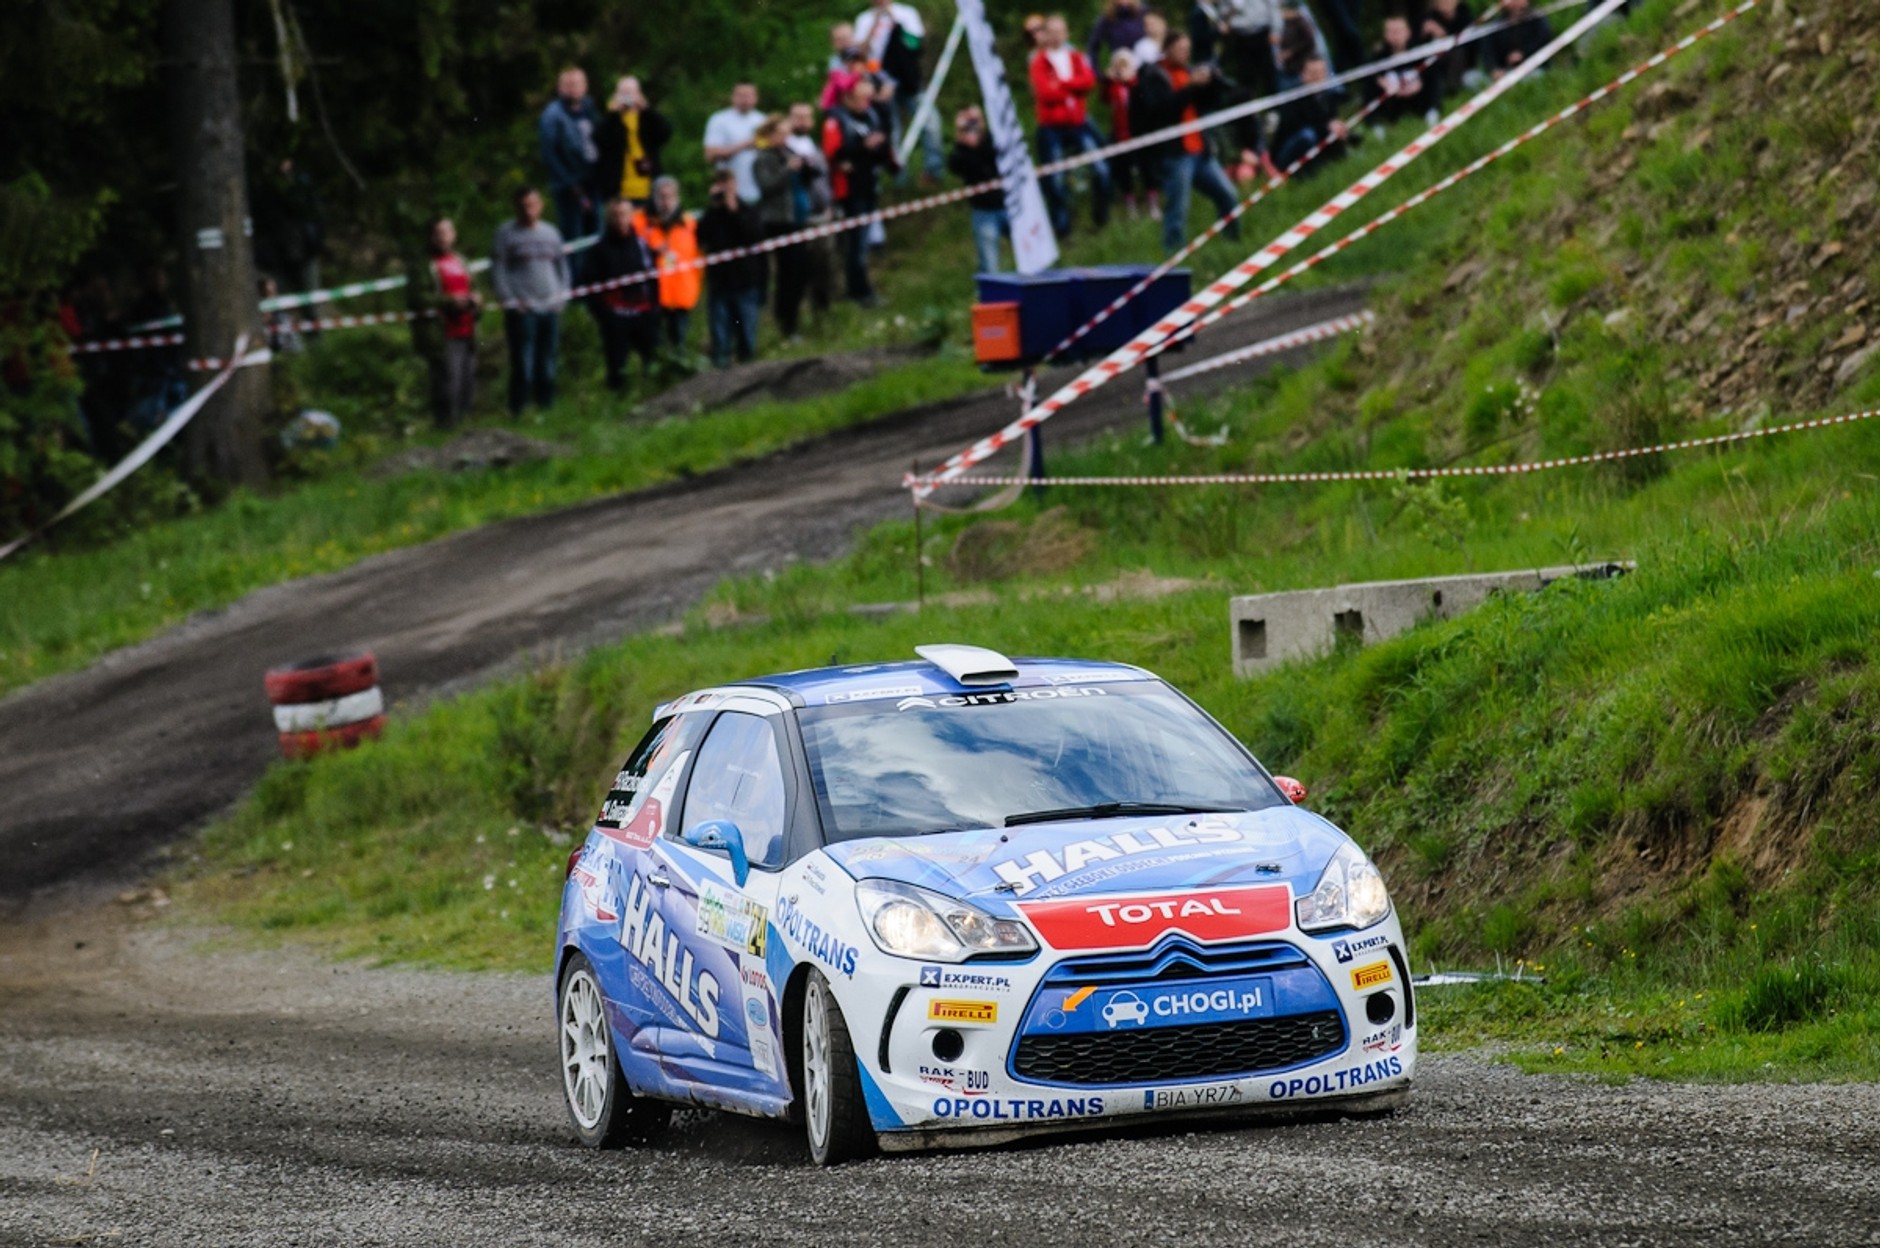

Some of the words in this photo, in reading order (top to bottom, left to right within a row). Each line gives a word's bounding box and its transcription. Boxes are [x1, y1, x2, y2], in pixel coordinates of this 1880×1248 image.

[938, 686, 1106, 706] CITROËN
[991, 821, 1245, 899] HALLS
[1086, 898, 1242, 927] TOTAL
[776, 896, 859, 976] OPOLTRANS
[620, 872, 720, 1039] HALLS
[944, 973, 1010, 988] EXPERT.PL
[1355, 965, 1391, 986] PIRELLI
[933, 1002, 993, 1020] PIRELLI
[1153, 987, 1263, 1016] CHOGI.pl
[1269, 1056, 1402, 1099] OPOLTRANS
[933, 1097, 1104, 1119] OPOLTRANS
[1157, 1091, 1186, 1107] BIA
